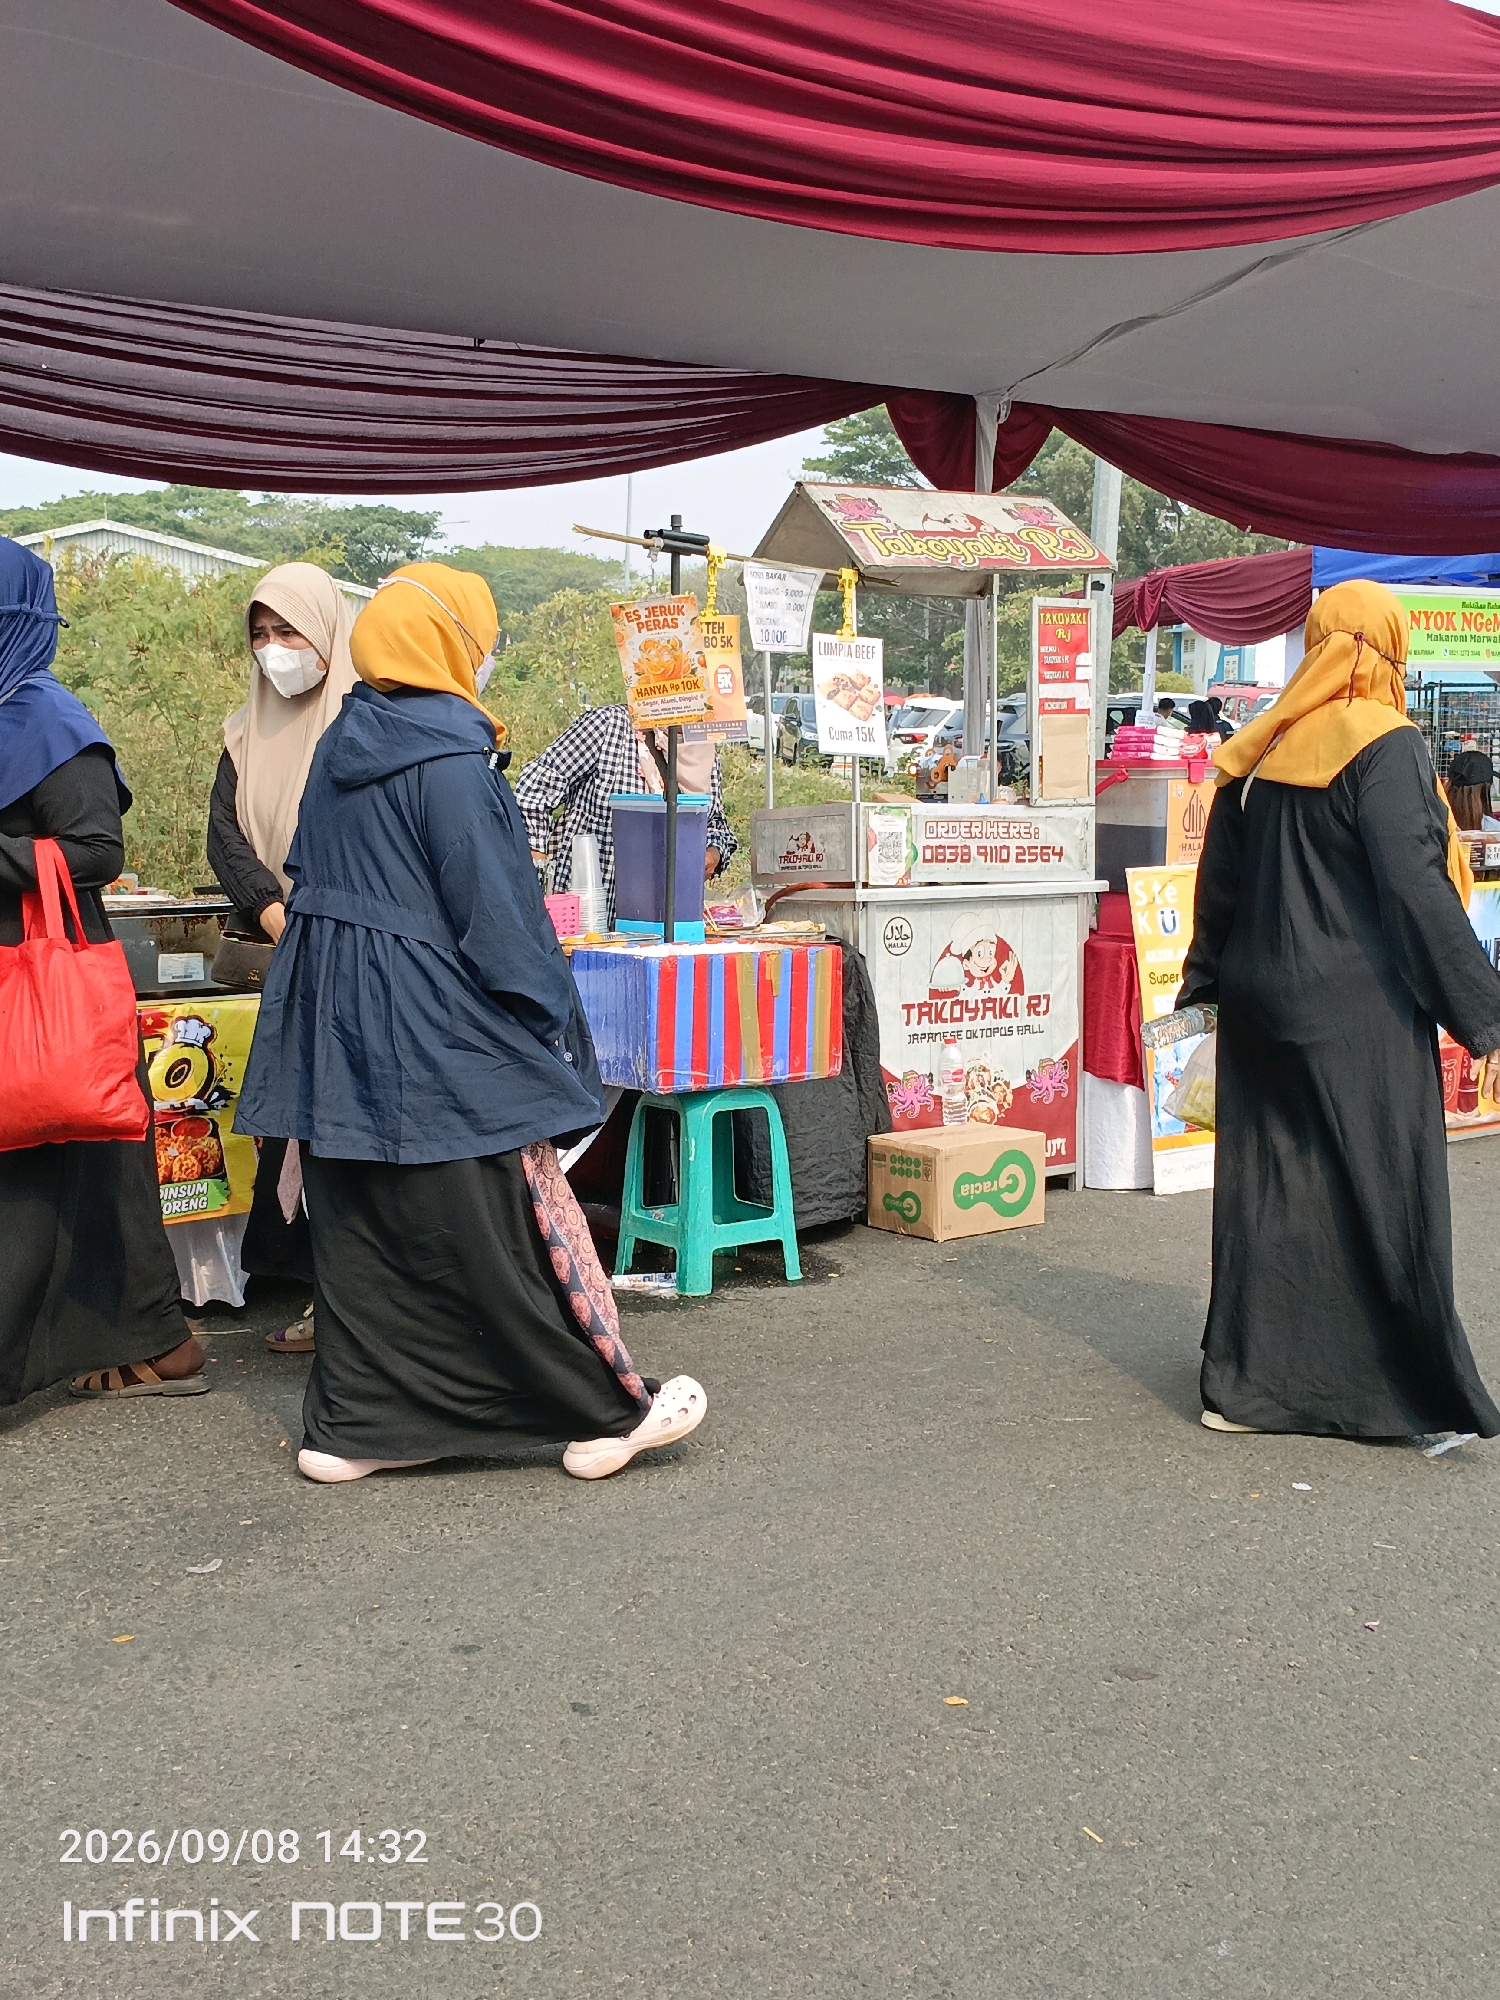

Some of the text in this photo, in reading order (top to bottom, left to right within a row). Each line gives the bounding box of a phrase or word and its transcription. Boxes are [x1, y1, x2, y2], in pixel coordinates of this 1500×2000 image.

[841, 521, 1097, 566] Takoyaki RJ
[766, 571, 787, 581] BAKAR
[624, 604, 686, 624] ES JERUK
[1040, 612, 1087, 626] TAKOYAKI
[1409, 610, 1457, 632] NYOK
[636, 618, 679, 634] PERAS
[705, 621, 725, 635] TEH
[720, 635, 734, 648] 5K
[1426, 633, 1467, 643] Makaroni
[818, 641, 876, 660] LUMPIA BEEF
[635, 679, 701, 699] HANYA Rp 10K
[828, 726, 876, 742] Cuma 15K
[924, 820, 983, 840] ORDER
[922, 845, 1064, 864] 0838 9110 2564
[1181, 842, 1202, 852] HALA
[1148, 972, 1180, 986] Super
[902, 994, 1051, 1027] TAKOYAKI RJ
[907, 1029, 963, 1045] JAPANESE
[965, 1025, 1014, 1039] OKTOPUS
[162, 1197, 208, 1215] ORENG
